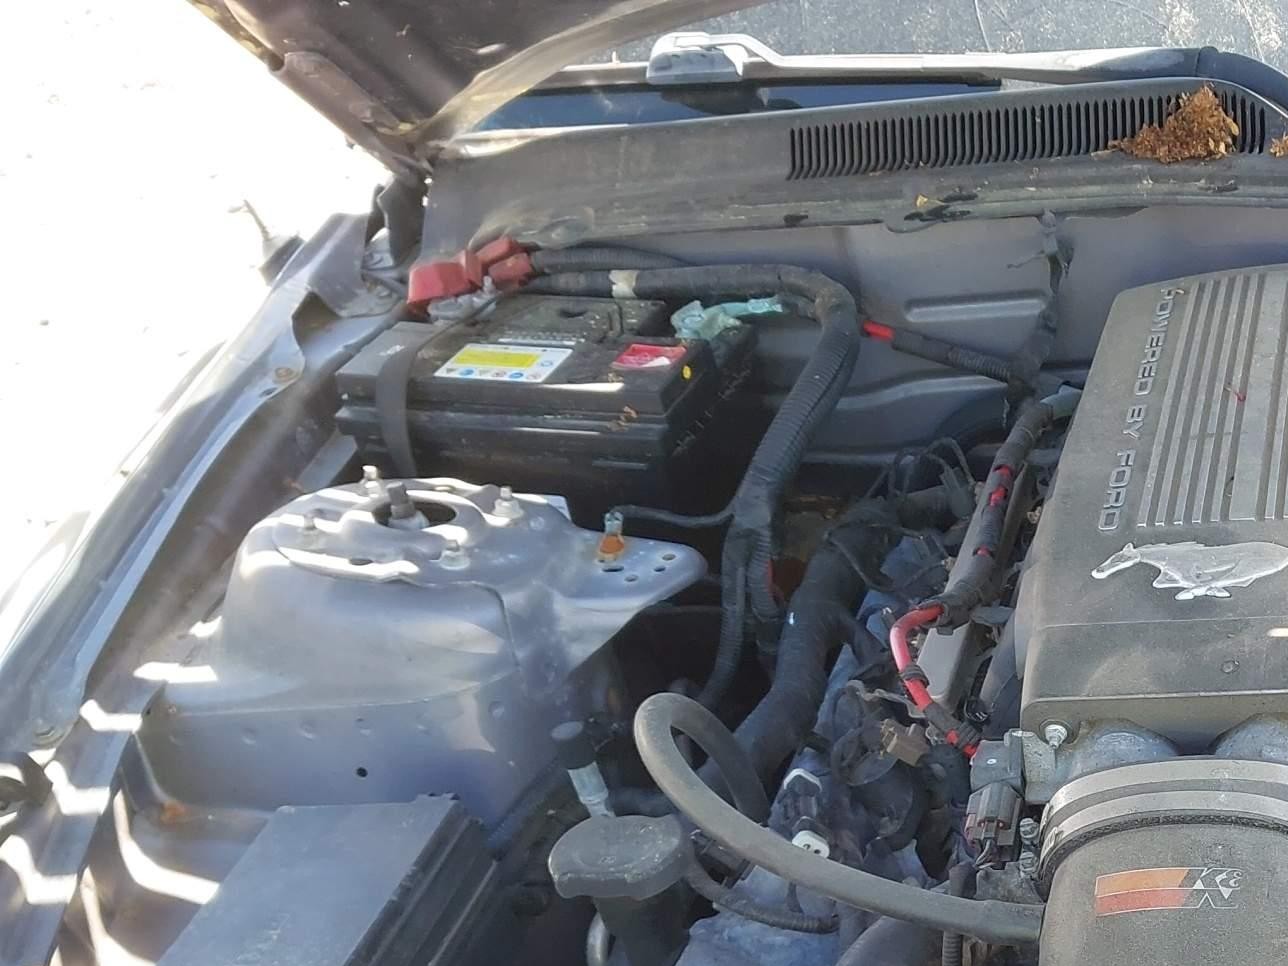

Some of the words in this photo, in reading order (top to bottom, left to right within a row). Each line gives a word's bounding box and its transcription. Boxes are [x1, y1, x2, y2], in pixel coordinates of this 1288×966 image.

[1134, 287, 1186, 397] POWERED
[1122, 404, 1147, 440] BY
[1098, 449, 1136, 532] FORD
